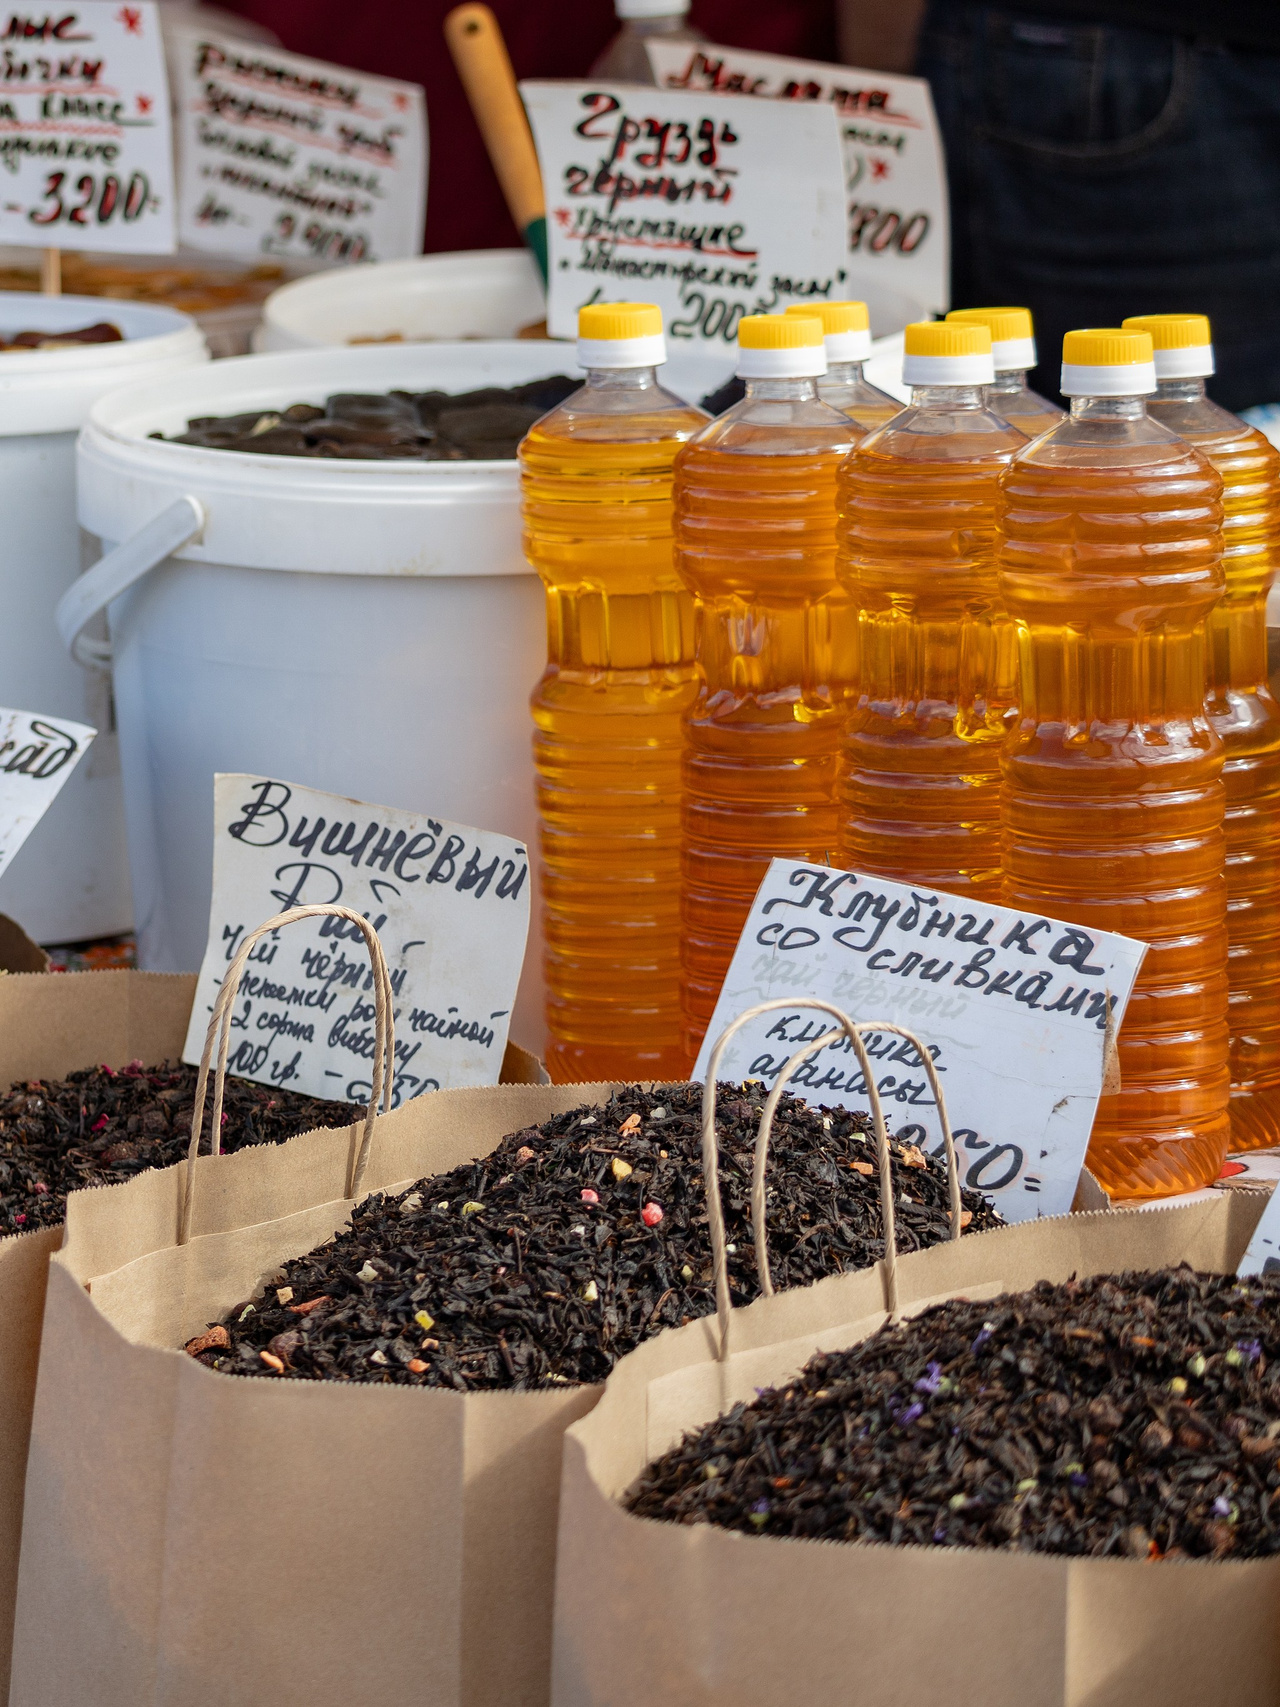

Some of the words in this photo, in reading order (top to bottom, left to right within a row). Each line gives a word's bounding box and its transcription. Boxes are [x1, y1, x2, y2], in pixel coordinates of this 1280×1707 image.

[575, 92, 740, 169] Груздь
[228, 781, 528, 900] Вишнёвый
[756, 921, 821, 952] со
[865, 946, 1120, 1031] сливками
[762, 867, 1107, 976] Клубника
[256, 1010, 315, 1049] сорта
